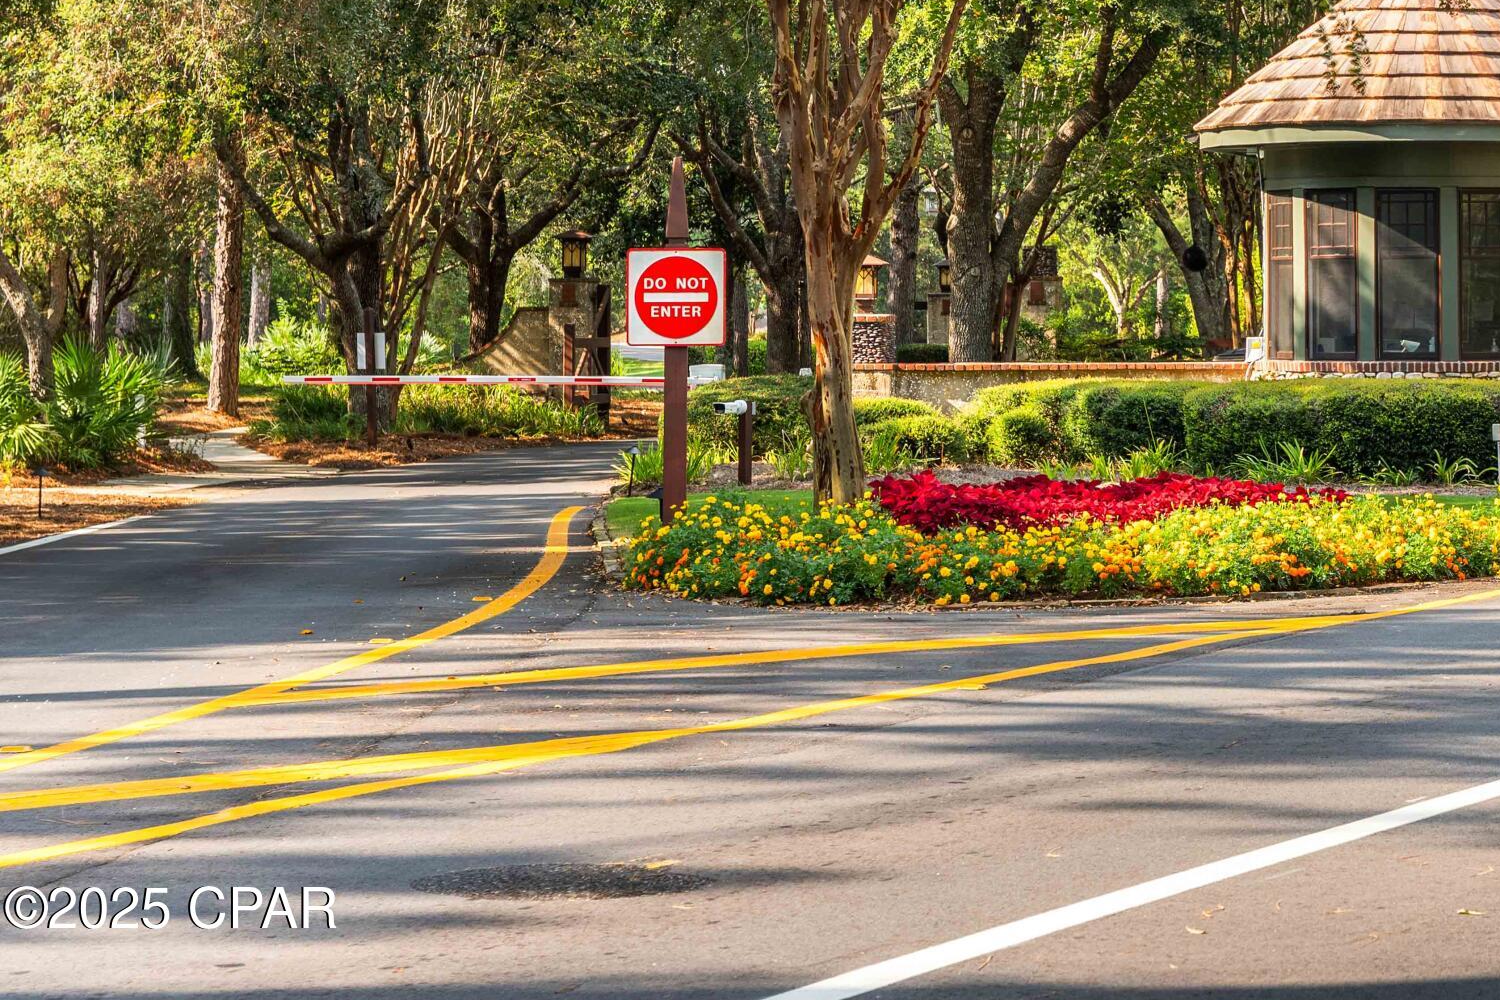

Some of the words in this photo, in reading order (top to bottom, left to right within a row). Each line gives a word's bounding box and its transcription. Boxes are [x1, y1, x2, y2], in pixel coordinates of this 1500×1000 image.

[643, 277, 667, 290] DO
[676, 277, 709, 290] NOT
[650, 305, 701, 318] ENTER
